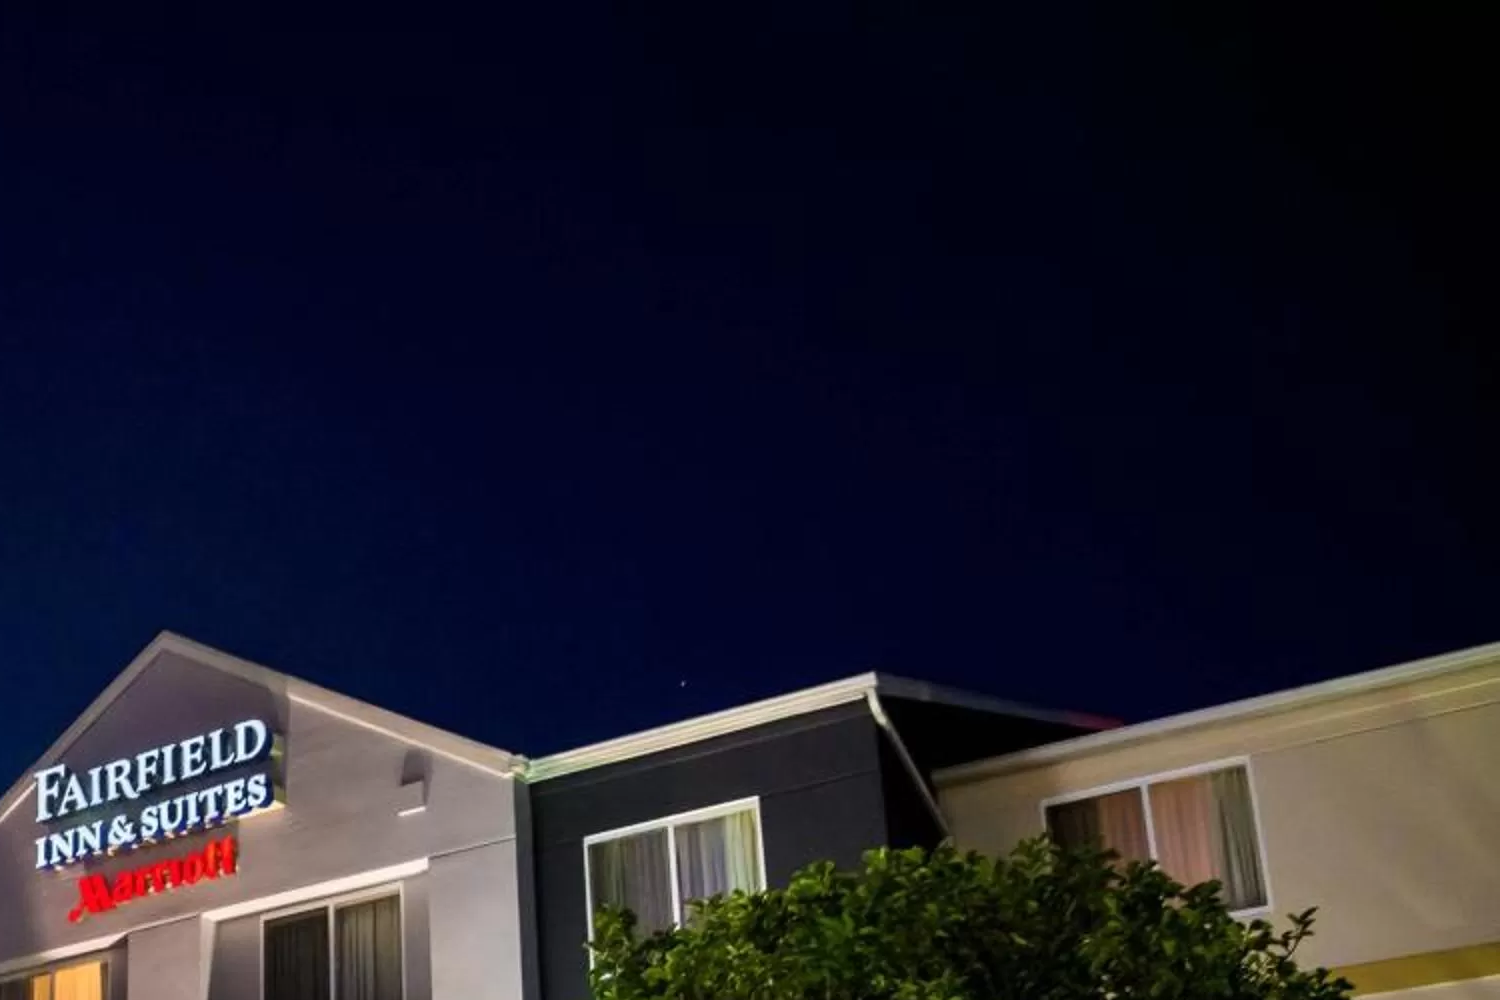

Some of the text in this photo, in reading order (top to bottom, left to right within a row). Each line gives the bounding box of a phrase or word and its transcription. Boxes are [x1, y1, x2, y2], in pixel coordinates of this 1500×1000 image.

[34, 719, 267, 823] FAIRFIELD
[35, 773, 267, 869] INN & SUITES
[68, 834, 238, 923] Marriott
